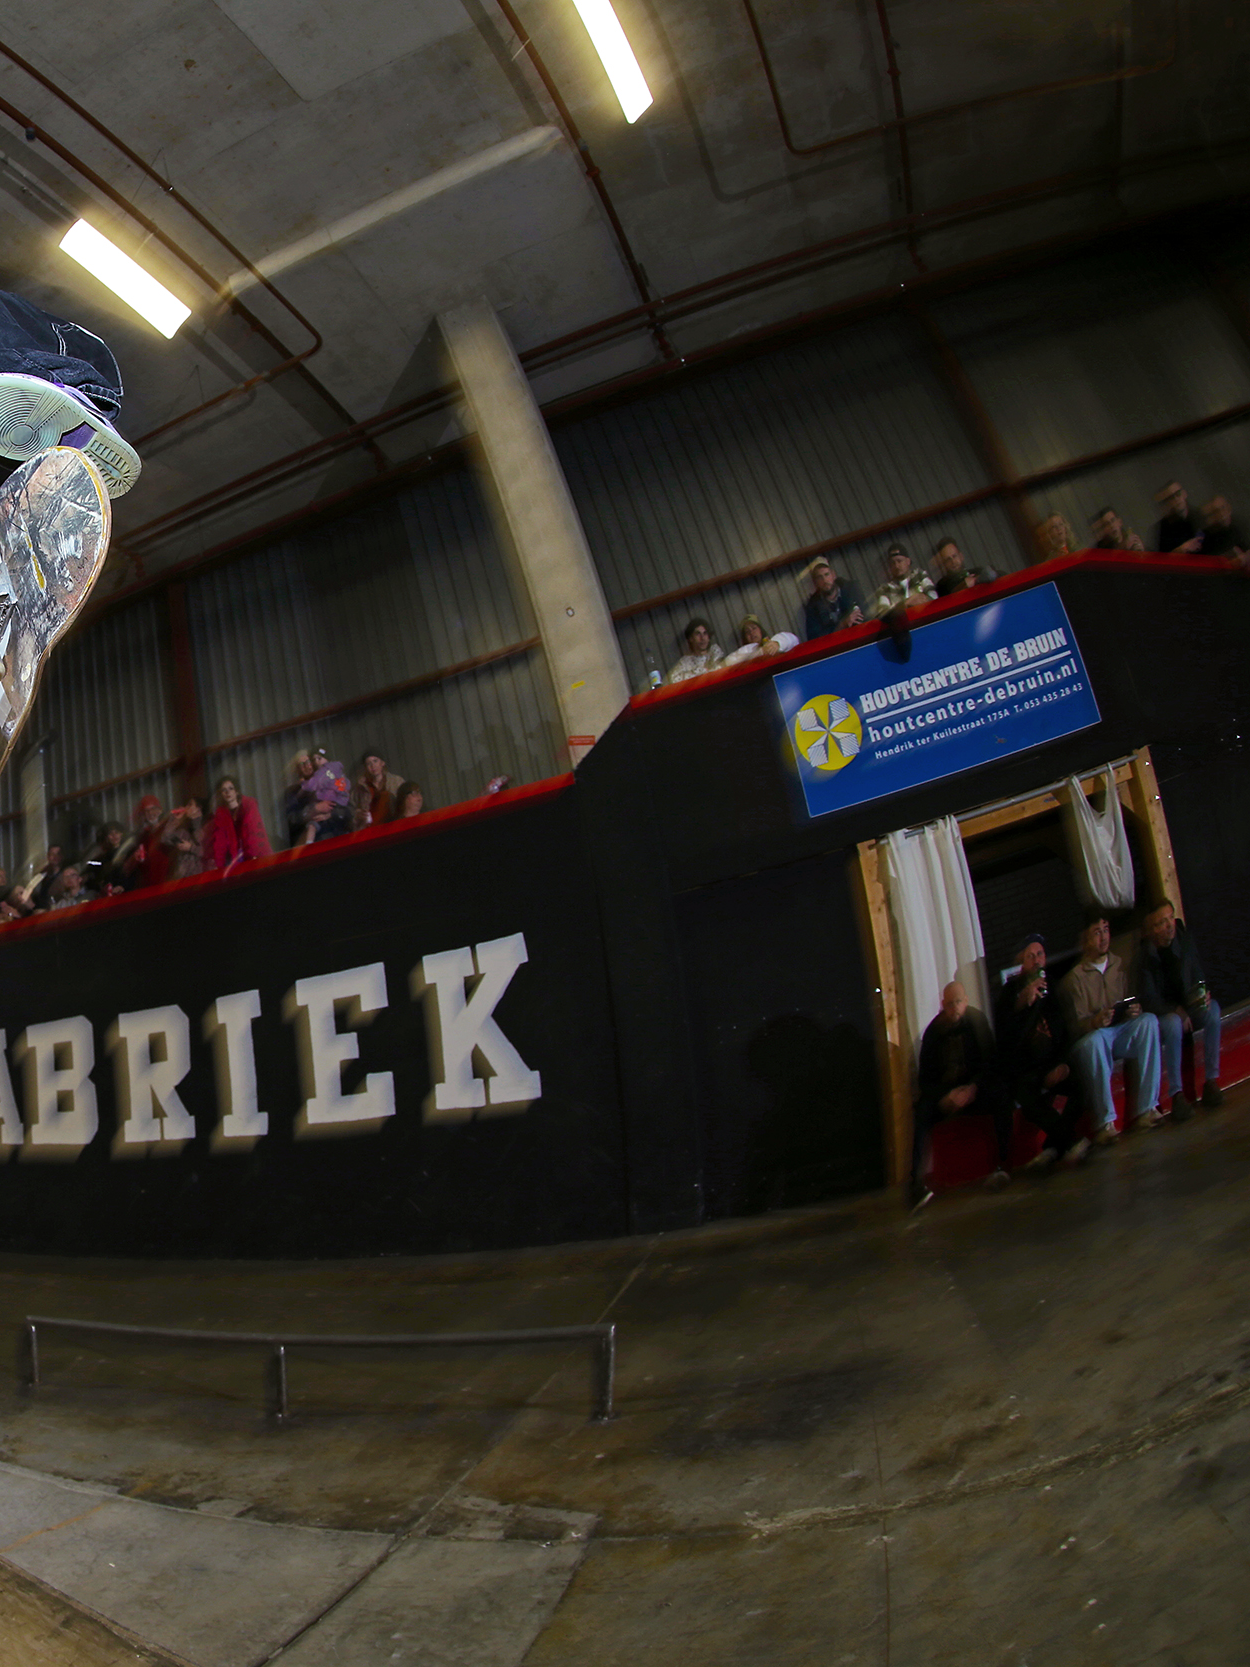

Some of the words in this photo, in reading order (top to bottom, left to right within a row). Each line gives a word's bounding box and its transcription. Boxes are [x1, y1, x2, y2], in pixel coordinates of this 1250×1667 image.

[859, 656, 984, 714] HOUTCENTRE
[985, 647, 1013, 672] DE
[1013, 627, 1068, 662] BRUIN
[868, 658, 1078, 743] houtcentre-debruin.nl
[874, 741, 915, 760] Hendrik
[916, 736, 932, 746] ter
[932, 717, 986, 741] Kuilestraat
[987, 708, 1010, 722] 175A
[1013, 704, 1023, 713] T.
[1023, 697, 1040, 710] 053
[1042, 691, 1058, 703] 435
[1060, 687, 1071, 697] 28
[1072, 682, 1083, 692] 43
